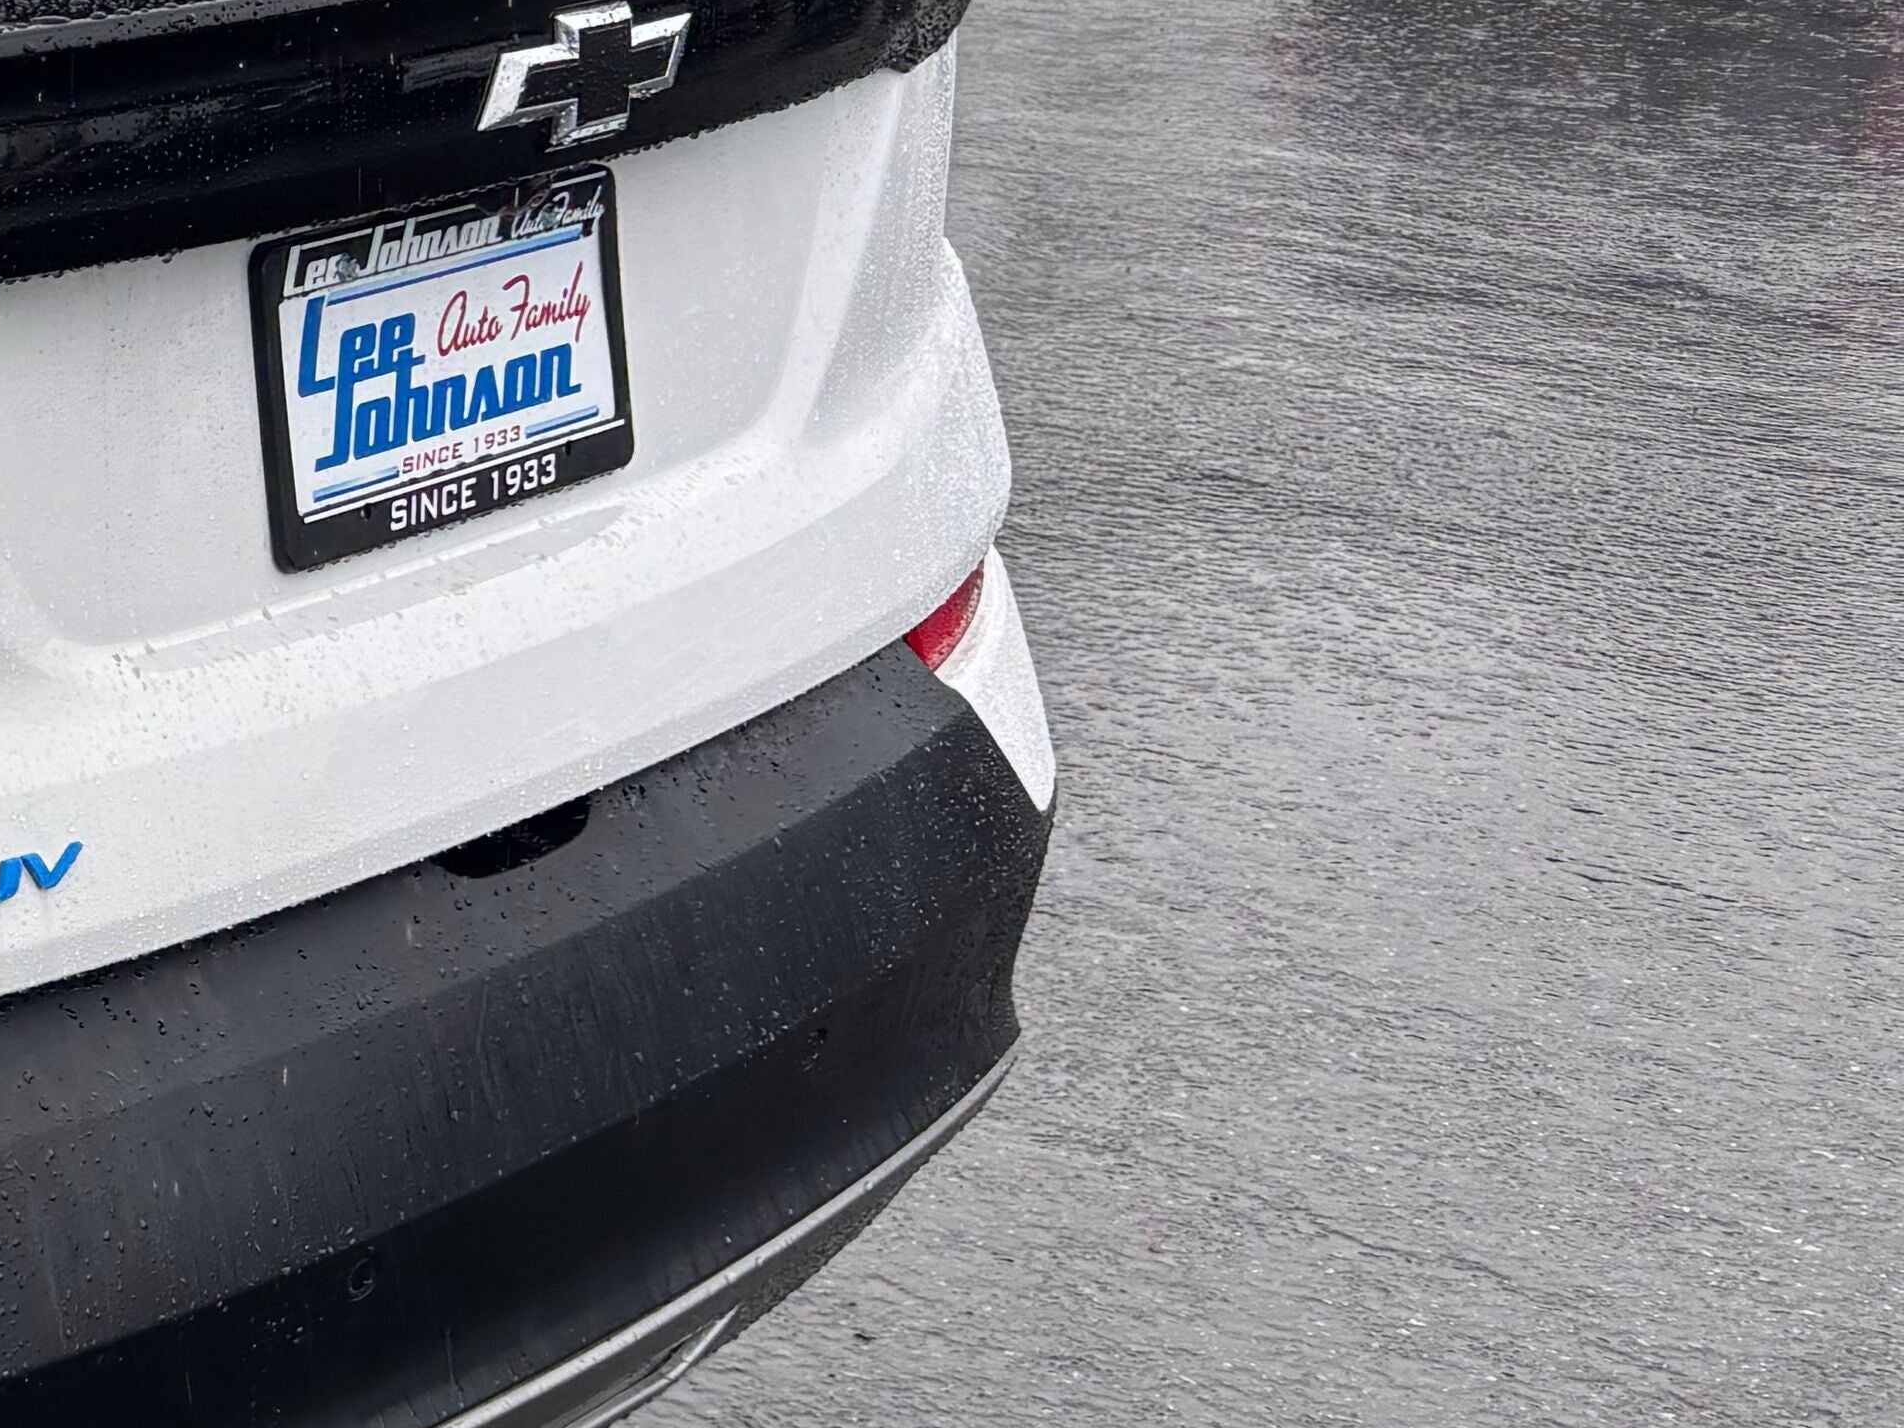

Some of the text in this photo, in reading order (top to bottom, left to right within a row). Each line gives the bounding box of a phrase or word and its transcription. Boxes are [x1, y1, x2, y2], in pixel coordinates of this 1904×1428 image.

[357, 217, 503, 273] Johnson
[552, 184, 605, 230] Family
[298, 261, 591, 398] Lee Auto Family
[314, 342, 582, 472] Johnson
[402, 425, 522, 474] SINCE 1933
[390, 453, 557, 531] SINCE 1933
